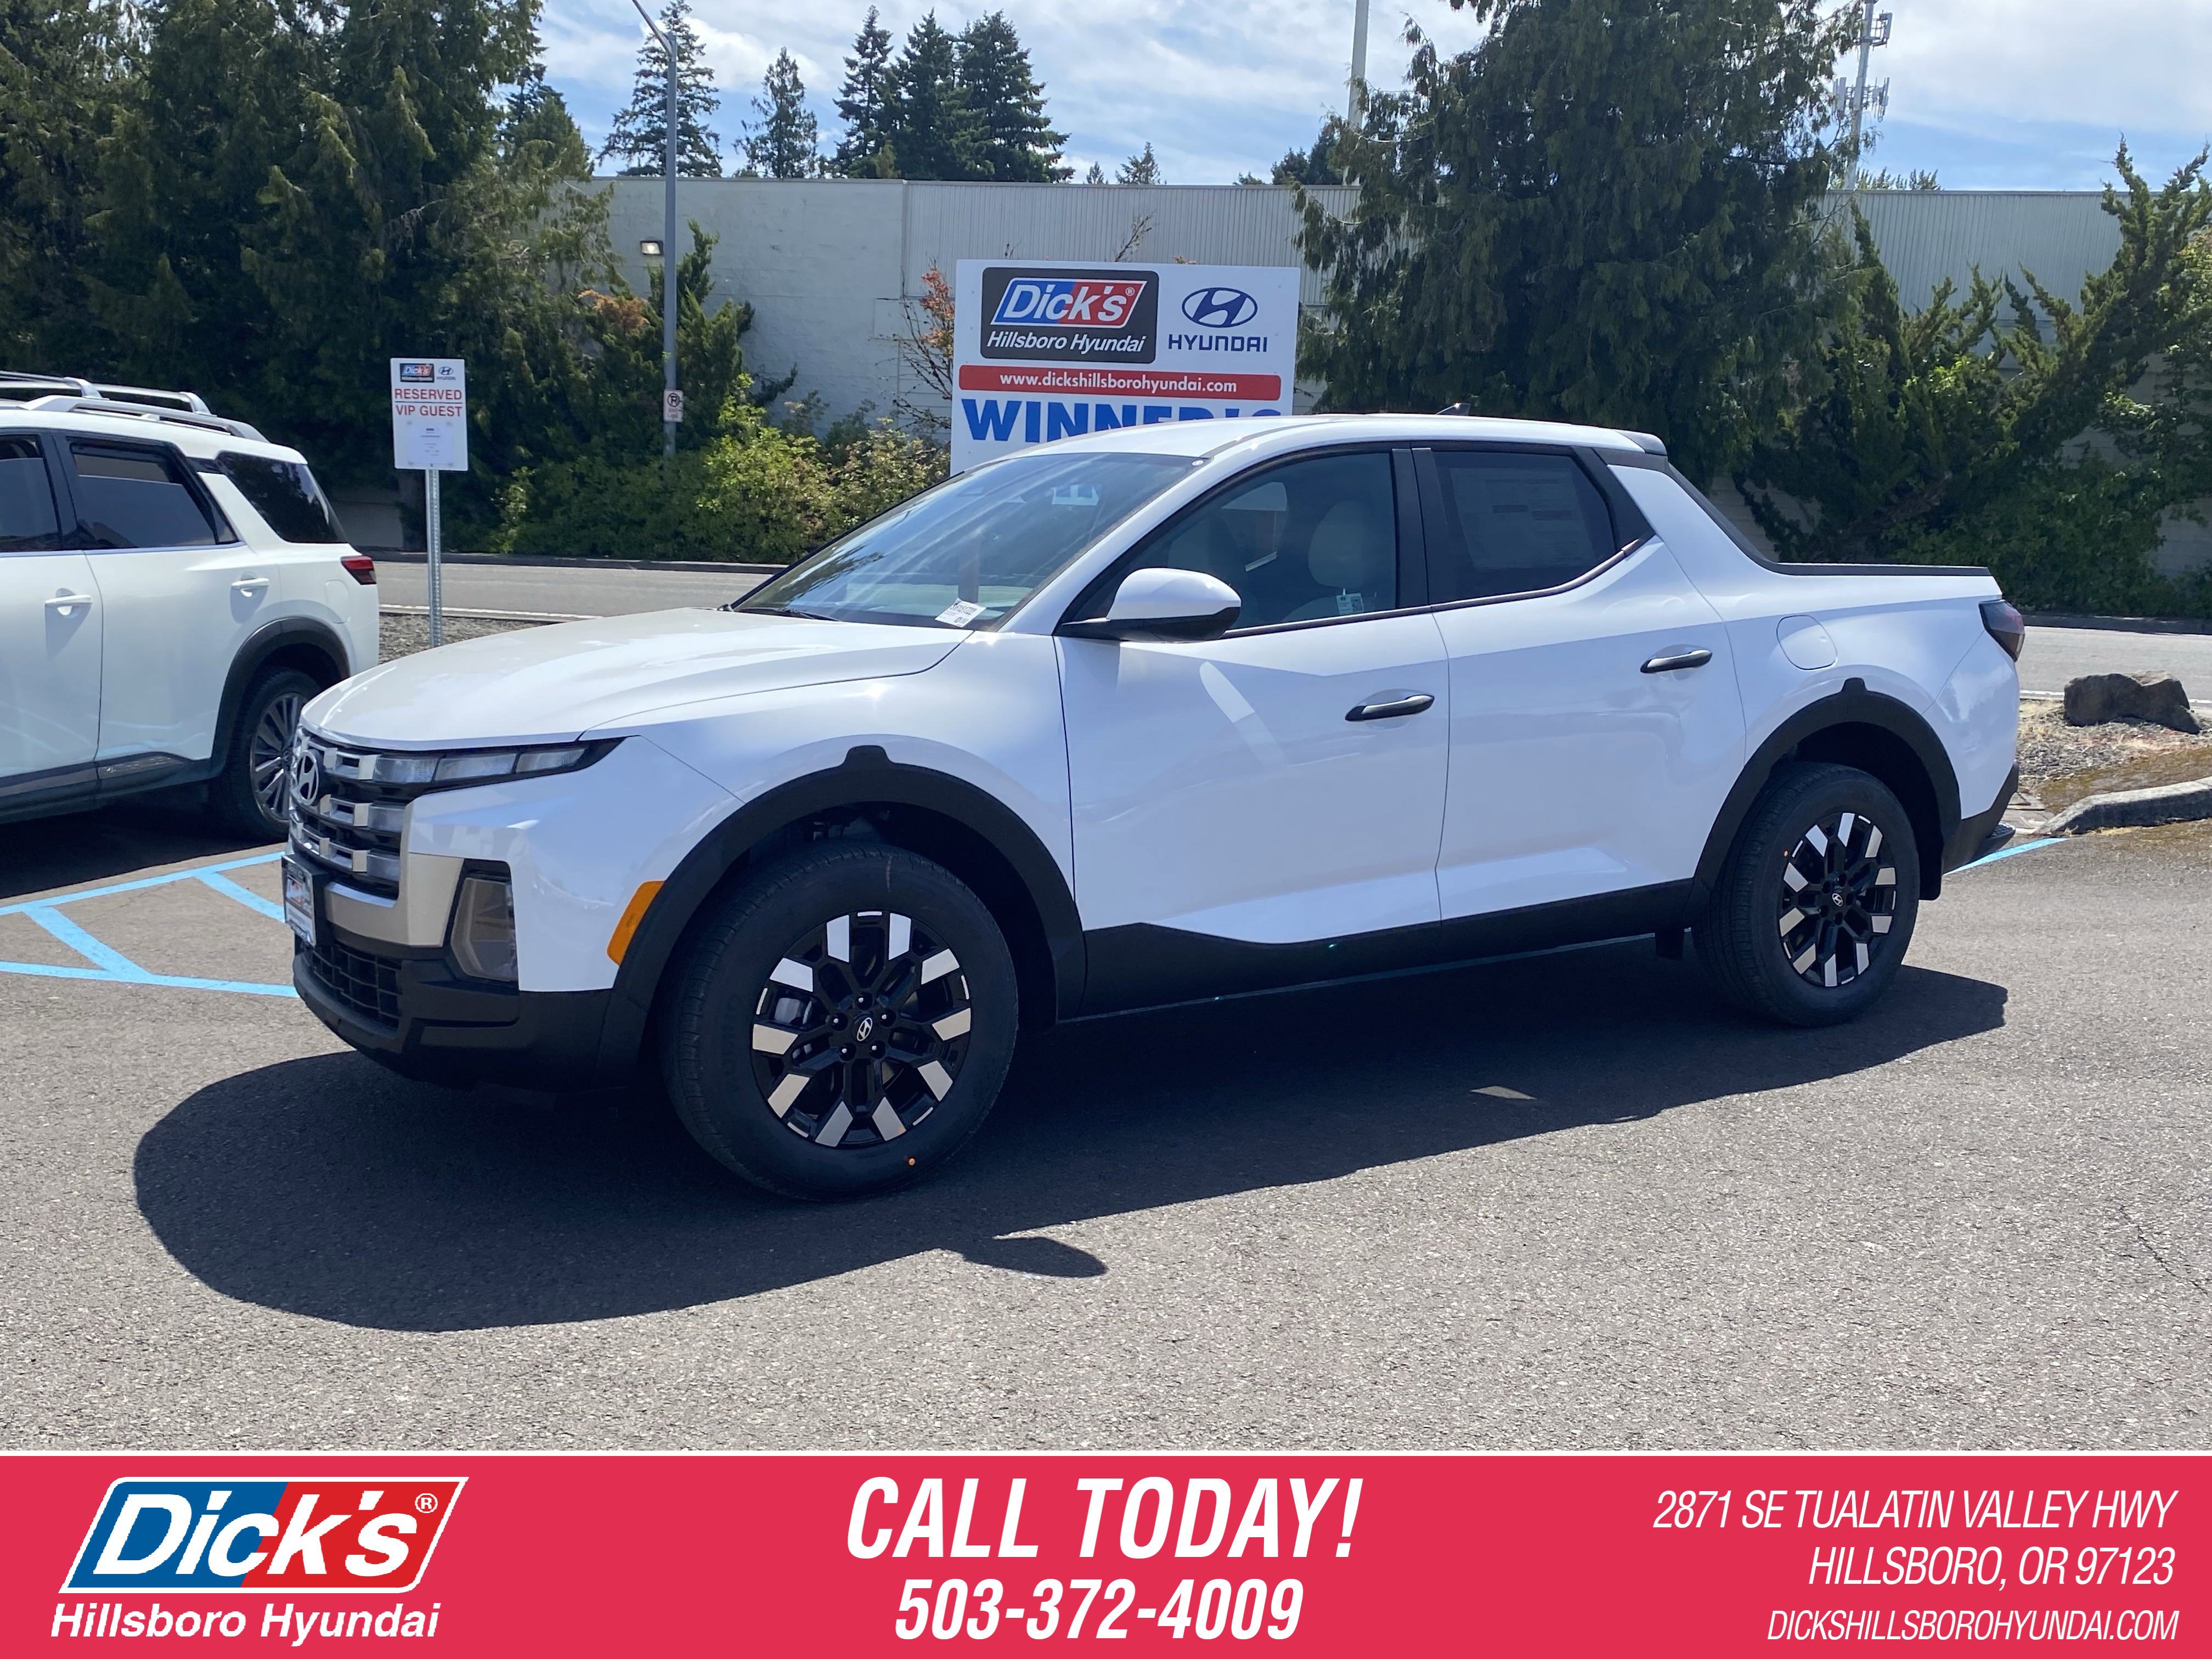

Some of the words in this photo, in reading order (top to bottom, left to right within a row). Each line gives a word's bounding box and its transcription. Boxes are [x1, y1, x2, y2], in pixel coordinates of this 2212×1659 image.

[986, 331, 1067, 349] Hillsboro
[1070, 333, 1147, 354] Hyundai
[1168, 334, 1268, 352] HYUNDAI
[999, 371, 1237, 393] www.dickshillsborohyundai.com
[394, 388, 462, 400] RESERVED
[396, 405, 415, 415] VIP
[420, 405, 462, 417] GUEST
[961, 398, 1281, 443] WINN'
